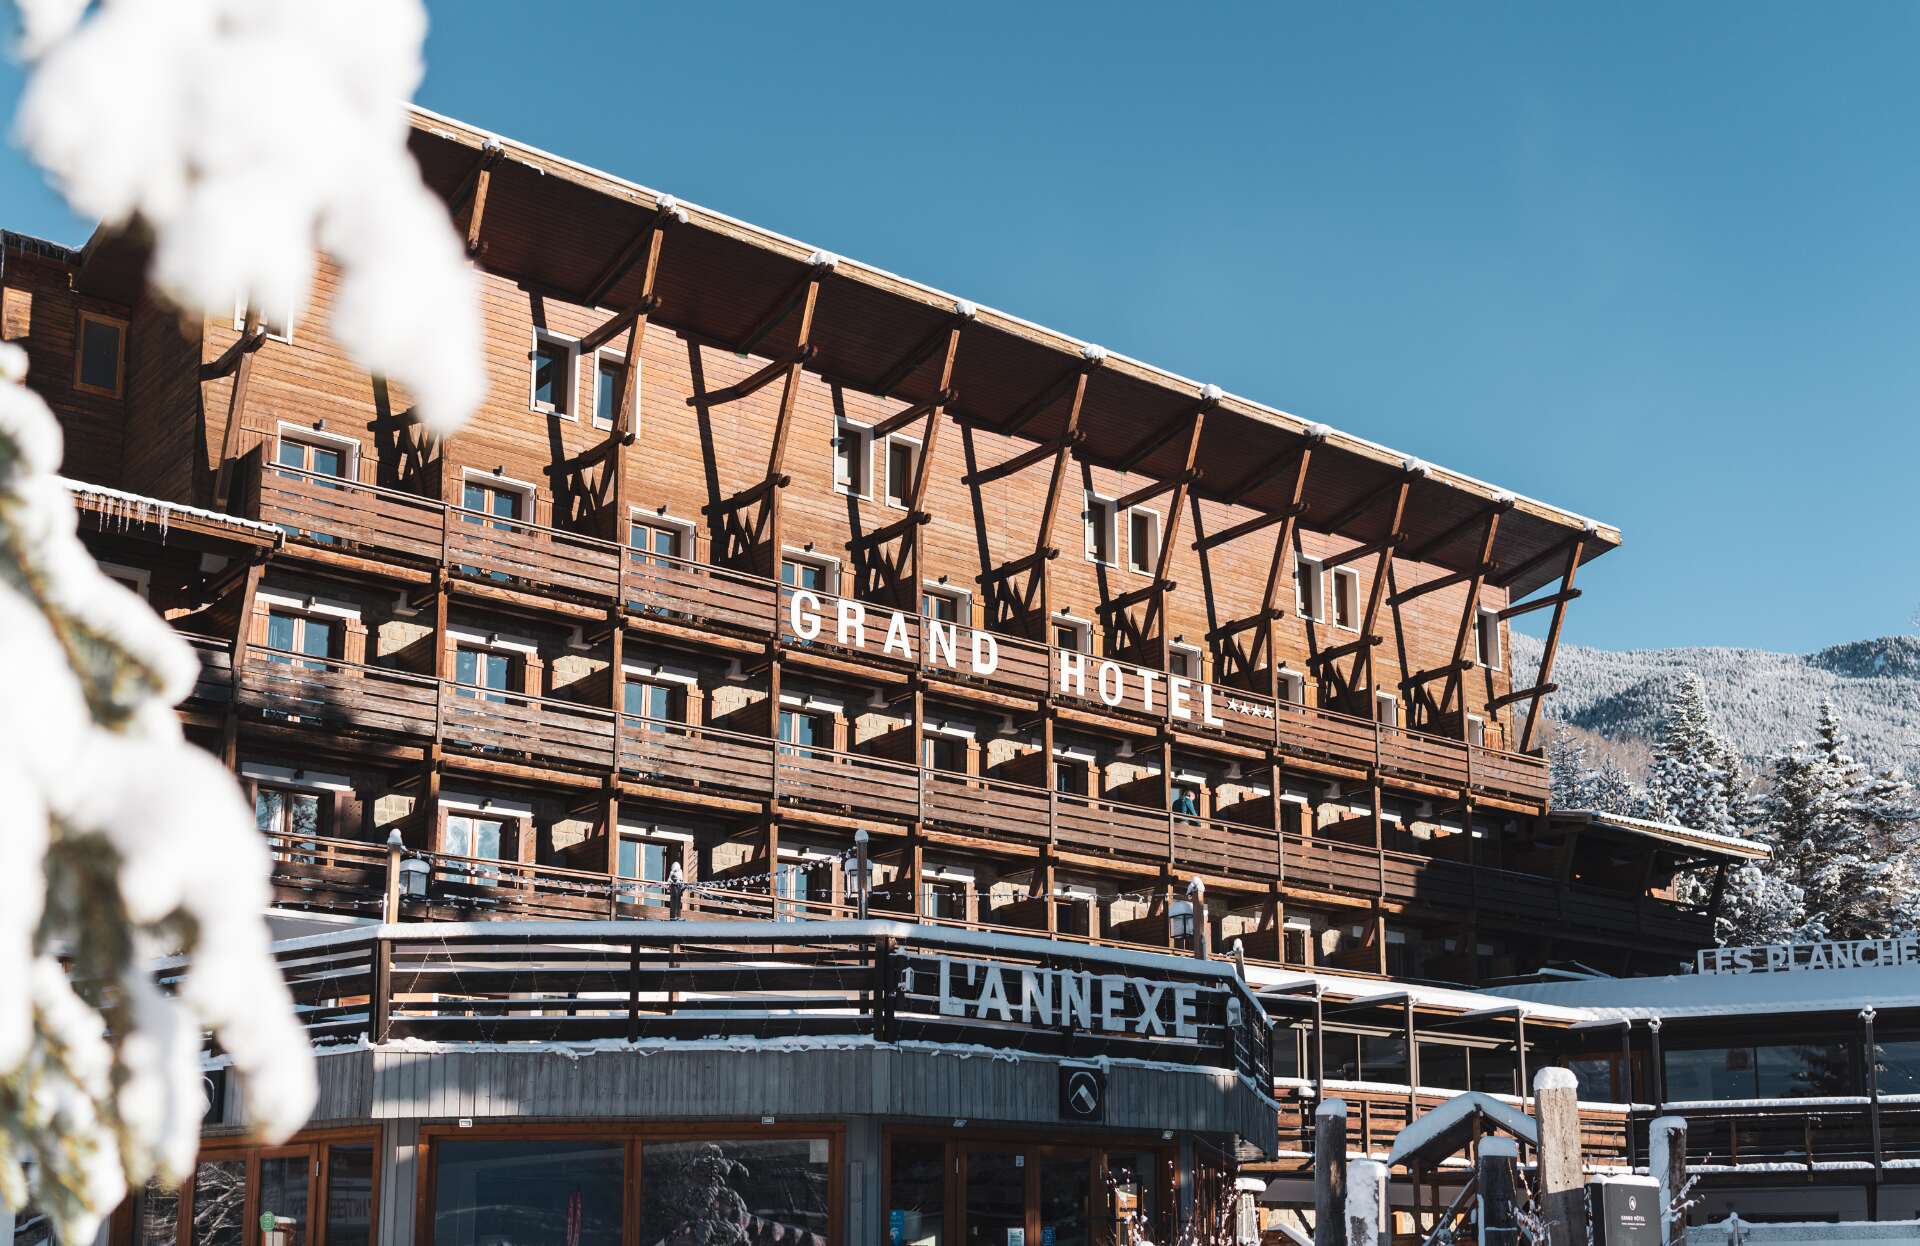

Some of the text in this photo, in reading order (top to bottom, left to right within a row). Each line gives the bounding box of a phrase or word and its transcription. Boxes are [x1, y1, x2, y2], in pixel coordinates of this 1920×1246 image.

[790, 590, 1224, 727] GRAND HOTEL
[938, 955, 1199, 1040] L'ANNEXE
[1697, 949, 1754, 976] LES
